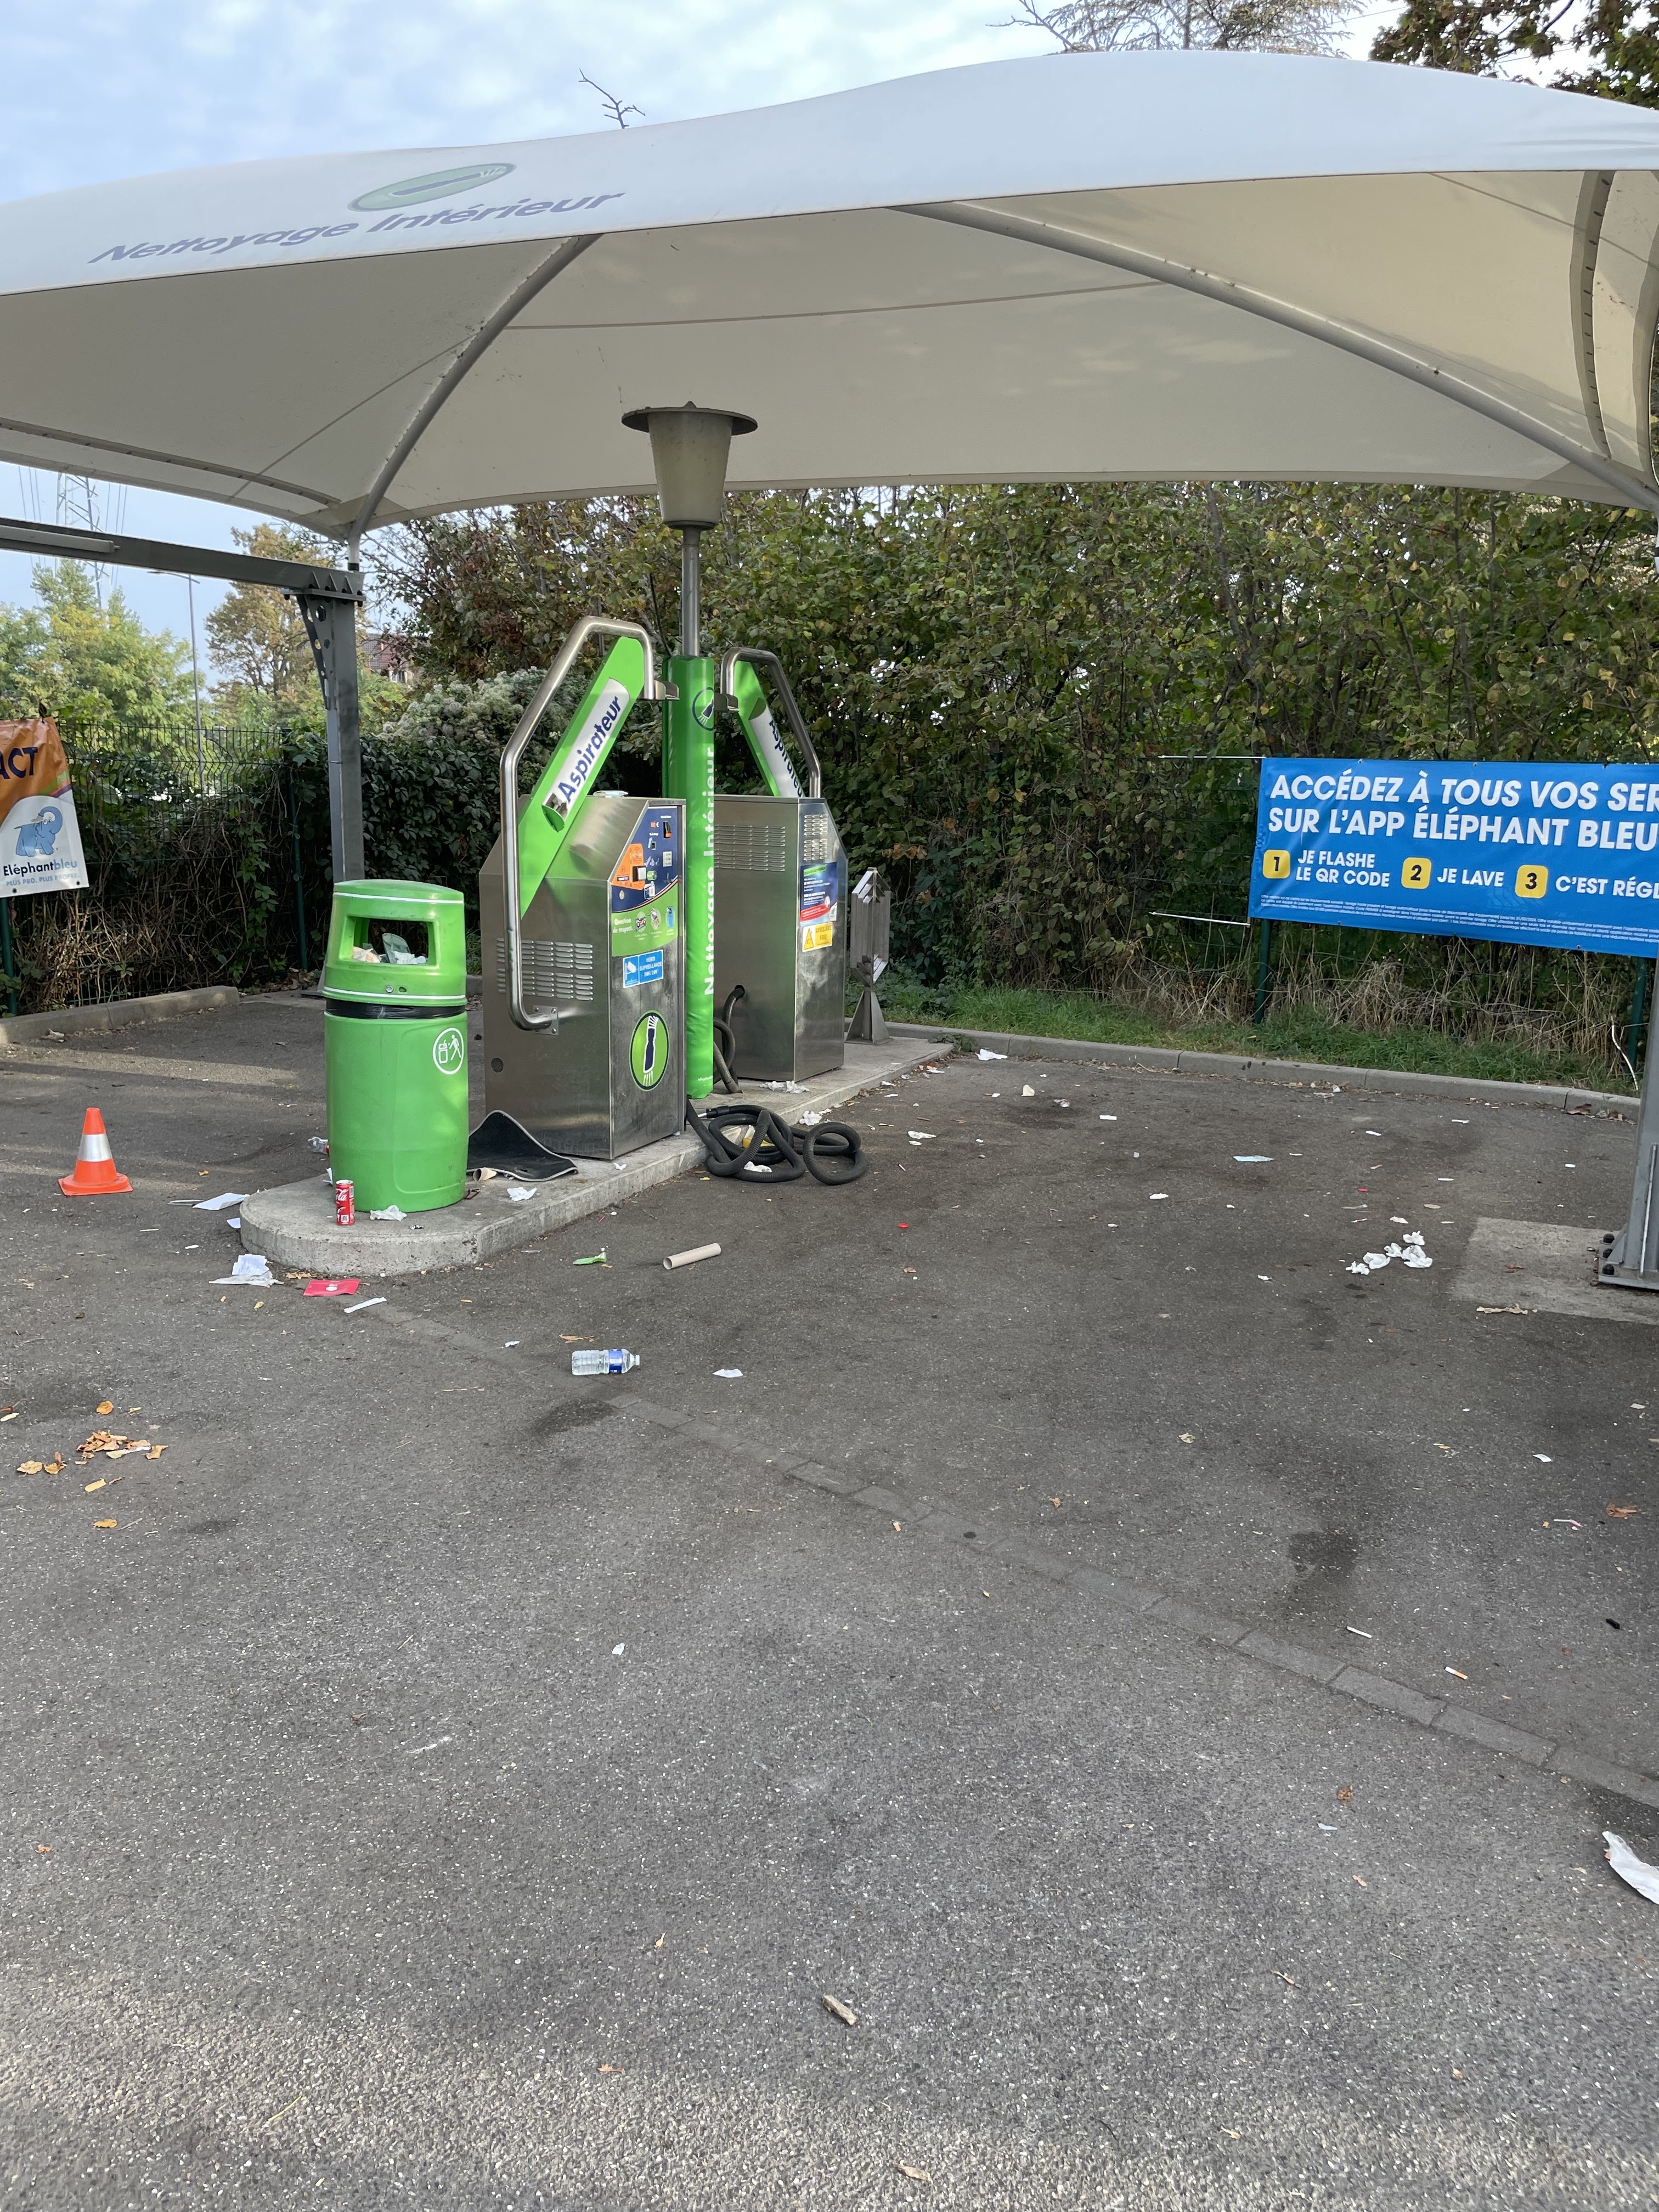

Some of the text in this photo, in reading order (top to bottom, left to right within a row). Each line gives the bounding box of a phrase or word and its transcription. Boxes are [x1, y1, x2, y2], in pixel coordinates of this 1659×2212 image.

[87, 193, 626, 264] Nettoyage Intérieur
[558, 696, 622, 804] Aspirateur
[769, 719, 803, 798] Aspirateu
[1270, 769, 1403, 802] ACCÉDEZ
[1407, 770, 1430, 803] À
[1441, 778, 1521, 806] TOUS
[1531, 781, 1599, 810] VOS
[702, 747, 714, 856] Intérieur
[1268, 805, 1658, 851] SUR L'APP ÉLÉPHANT BLEU
[1273, 856, 1280, 872] 1
[1298, 850, 1375, 868] JE FLASHE
[1295, 867, 1390, 887] LE QR CODE
[1410, 864, 1422, 881] 2
[1437, 868, 1504, 887] JE LAVE
[1525, 872, 1537, 889] 3
[1555, 876, 1608, 894] C'EST
